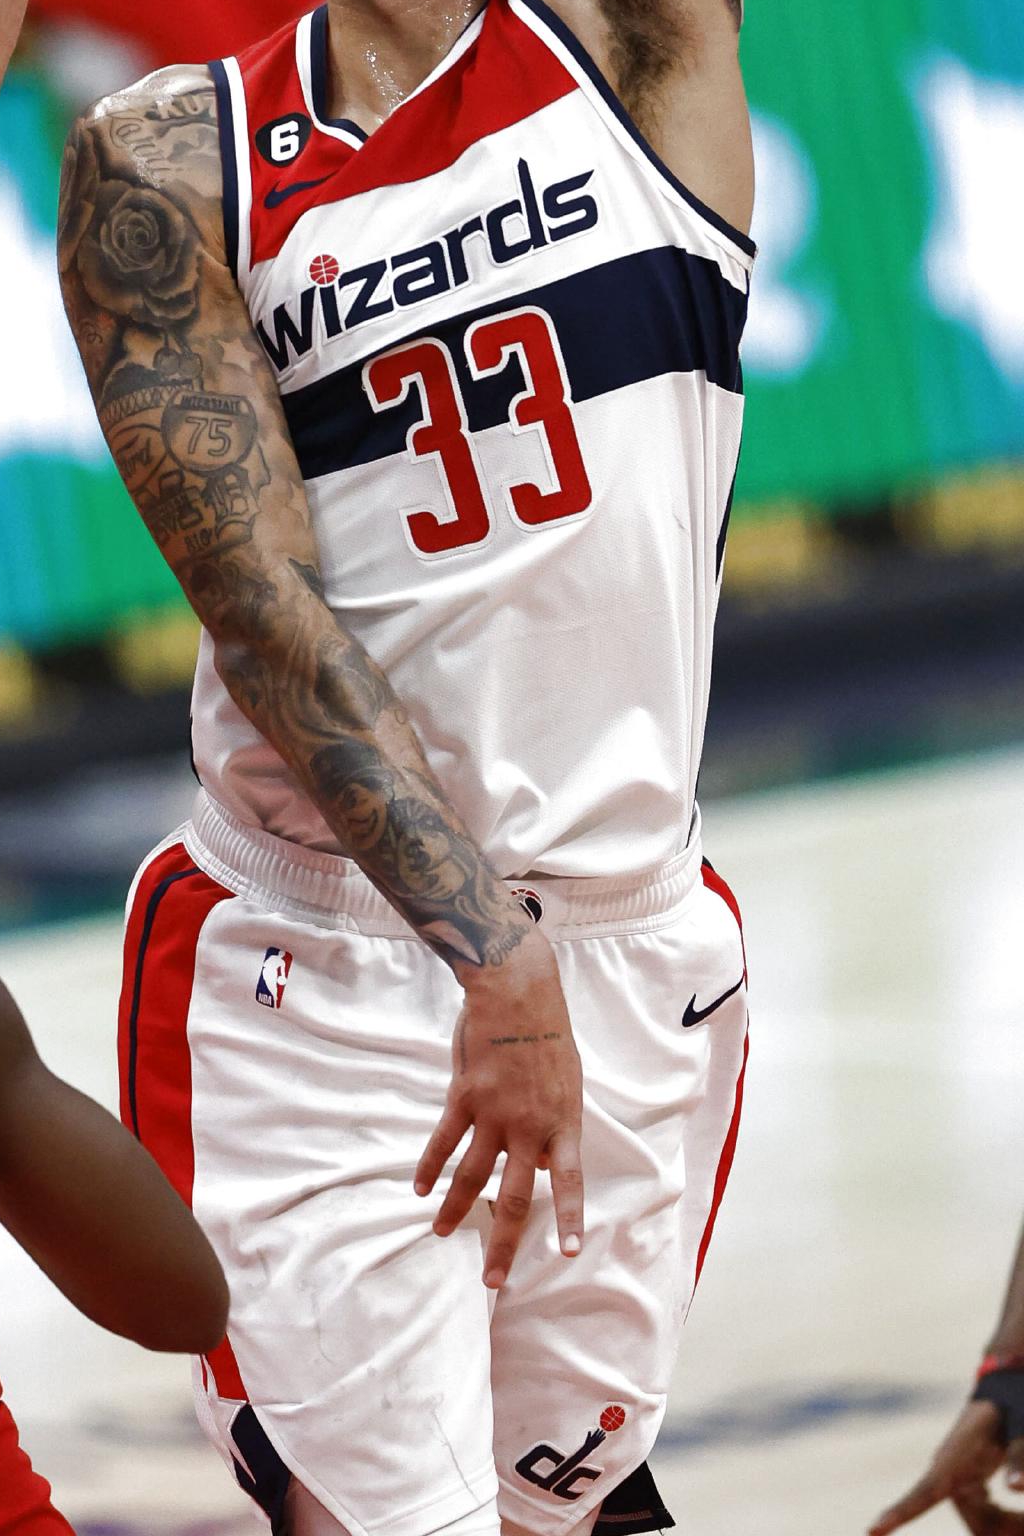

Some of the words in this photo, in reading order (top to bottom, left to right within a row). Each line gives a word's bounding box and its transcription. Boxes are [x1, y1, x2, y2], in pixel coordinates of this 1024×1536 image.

[270, 120, 299, 161] 6
[257, 157, 599, 370] wizards
[184, 415, 233, 457] 75
[362, 304, 593, 562] 33
